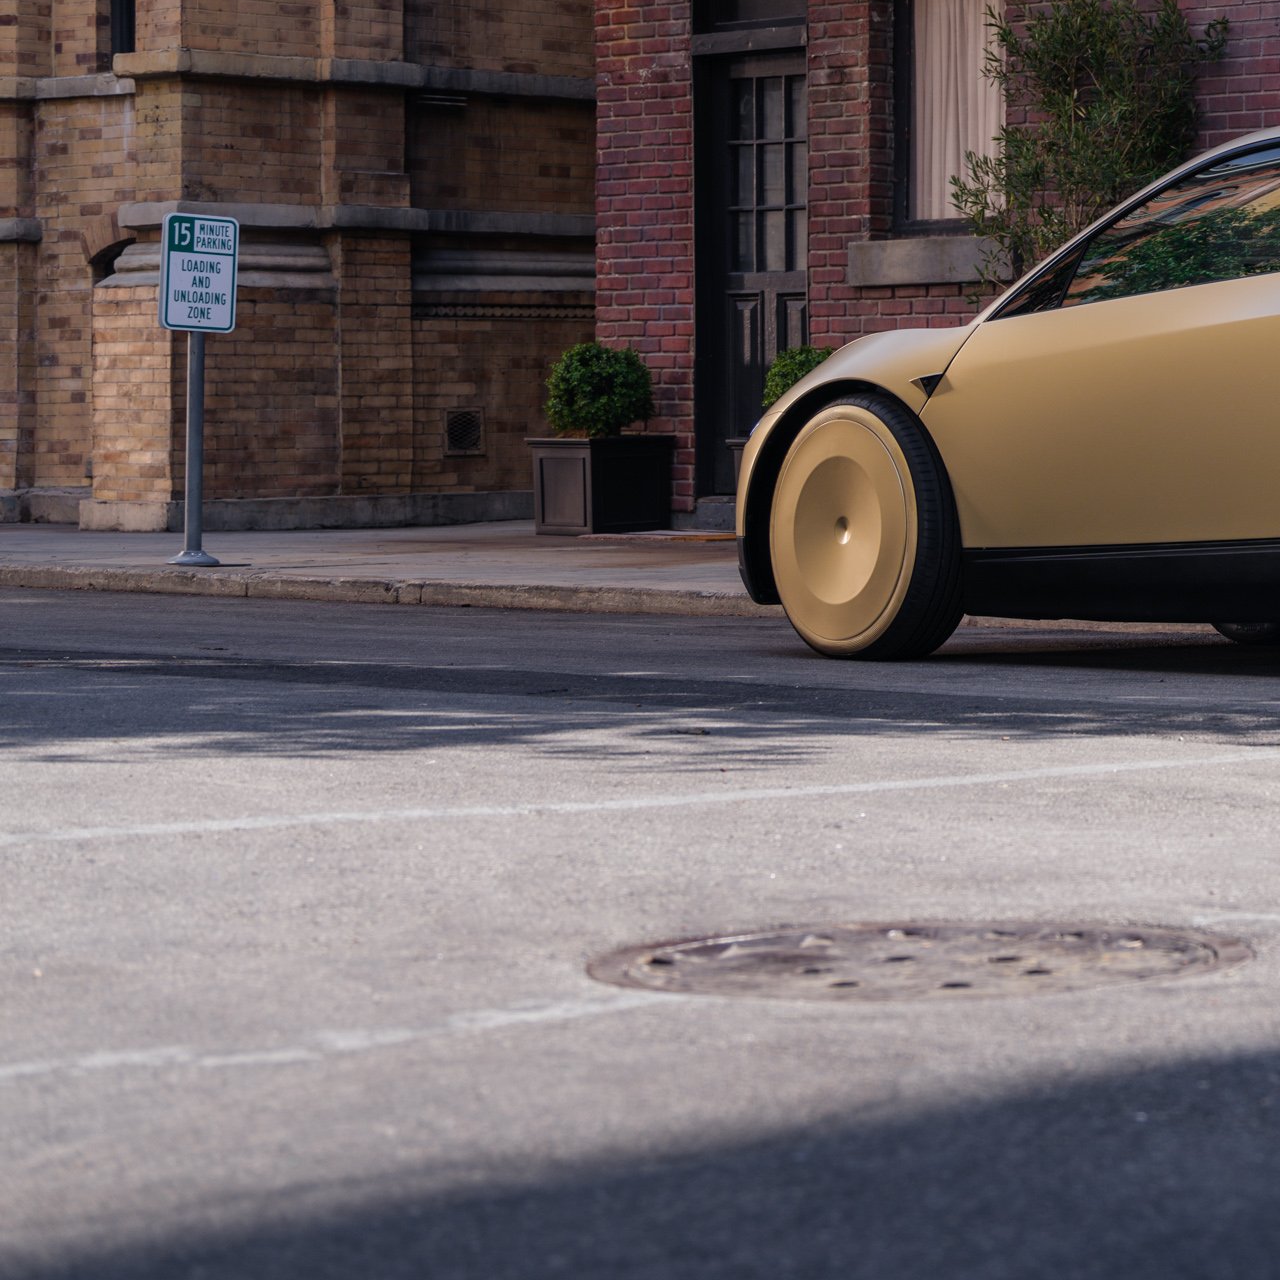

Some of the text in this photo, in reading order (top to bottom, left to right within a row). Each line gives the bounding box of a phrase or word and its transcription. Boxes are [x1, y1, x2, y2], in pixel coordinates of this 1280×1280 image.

[173, 222, 191, 246] 15
[199, 223, 230, 238] MINUTE
[196, 238, 232, 251] PARKING
[181, 259, 221, 274] LOADING
[191, 276, 211, 289] AND
[173, 290, 227, 305] UNLOADING
[187, 306, 212, 320] ZONE
